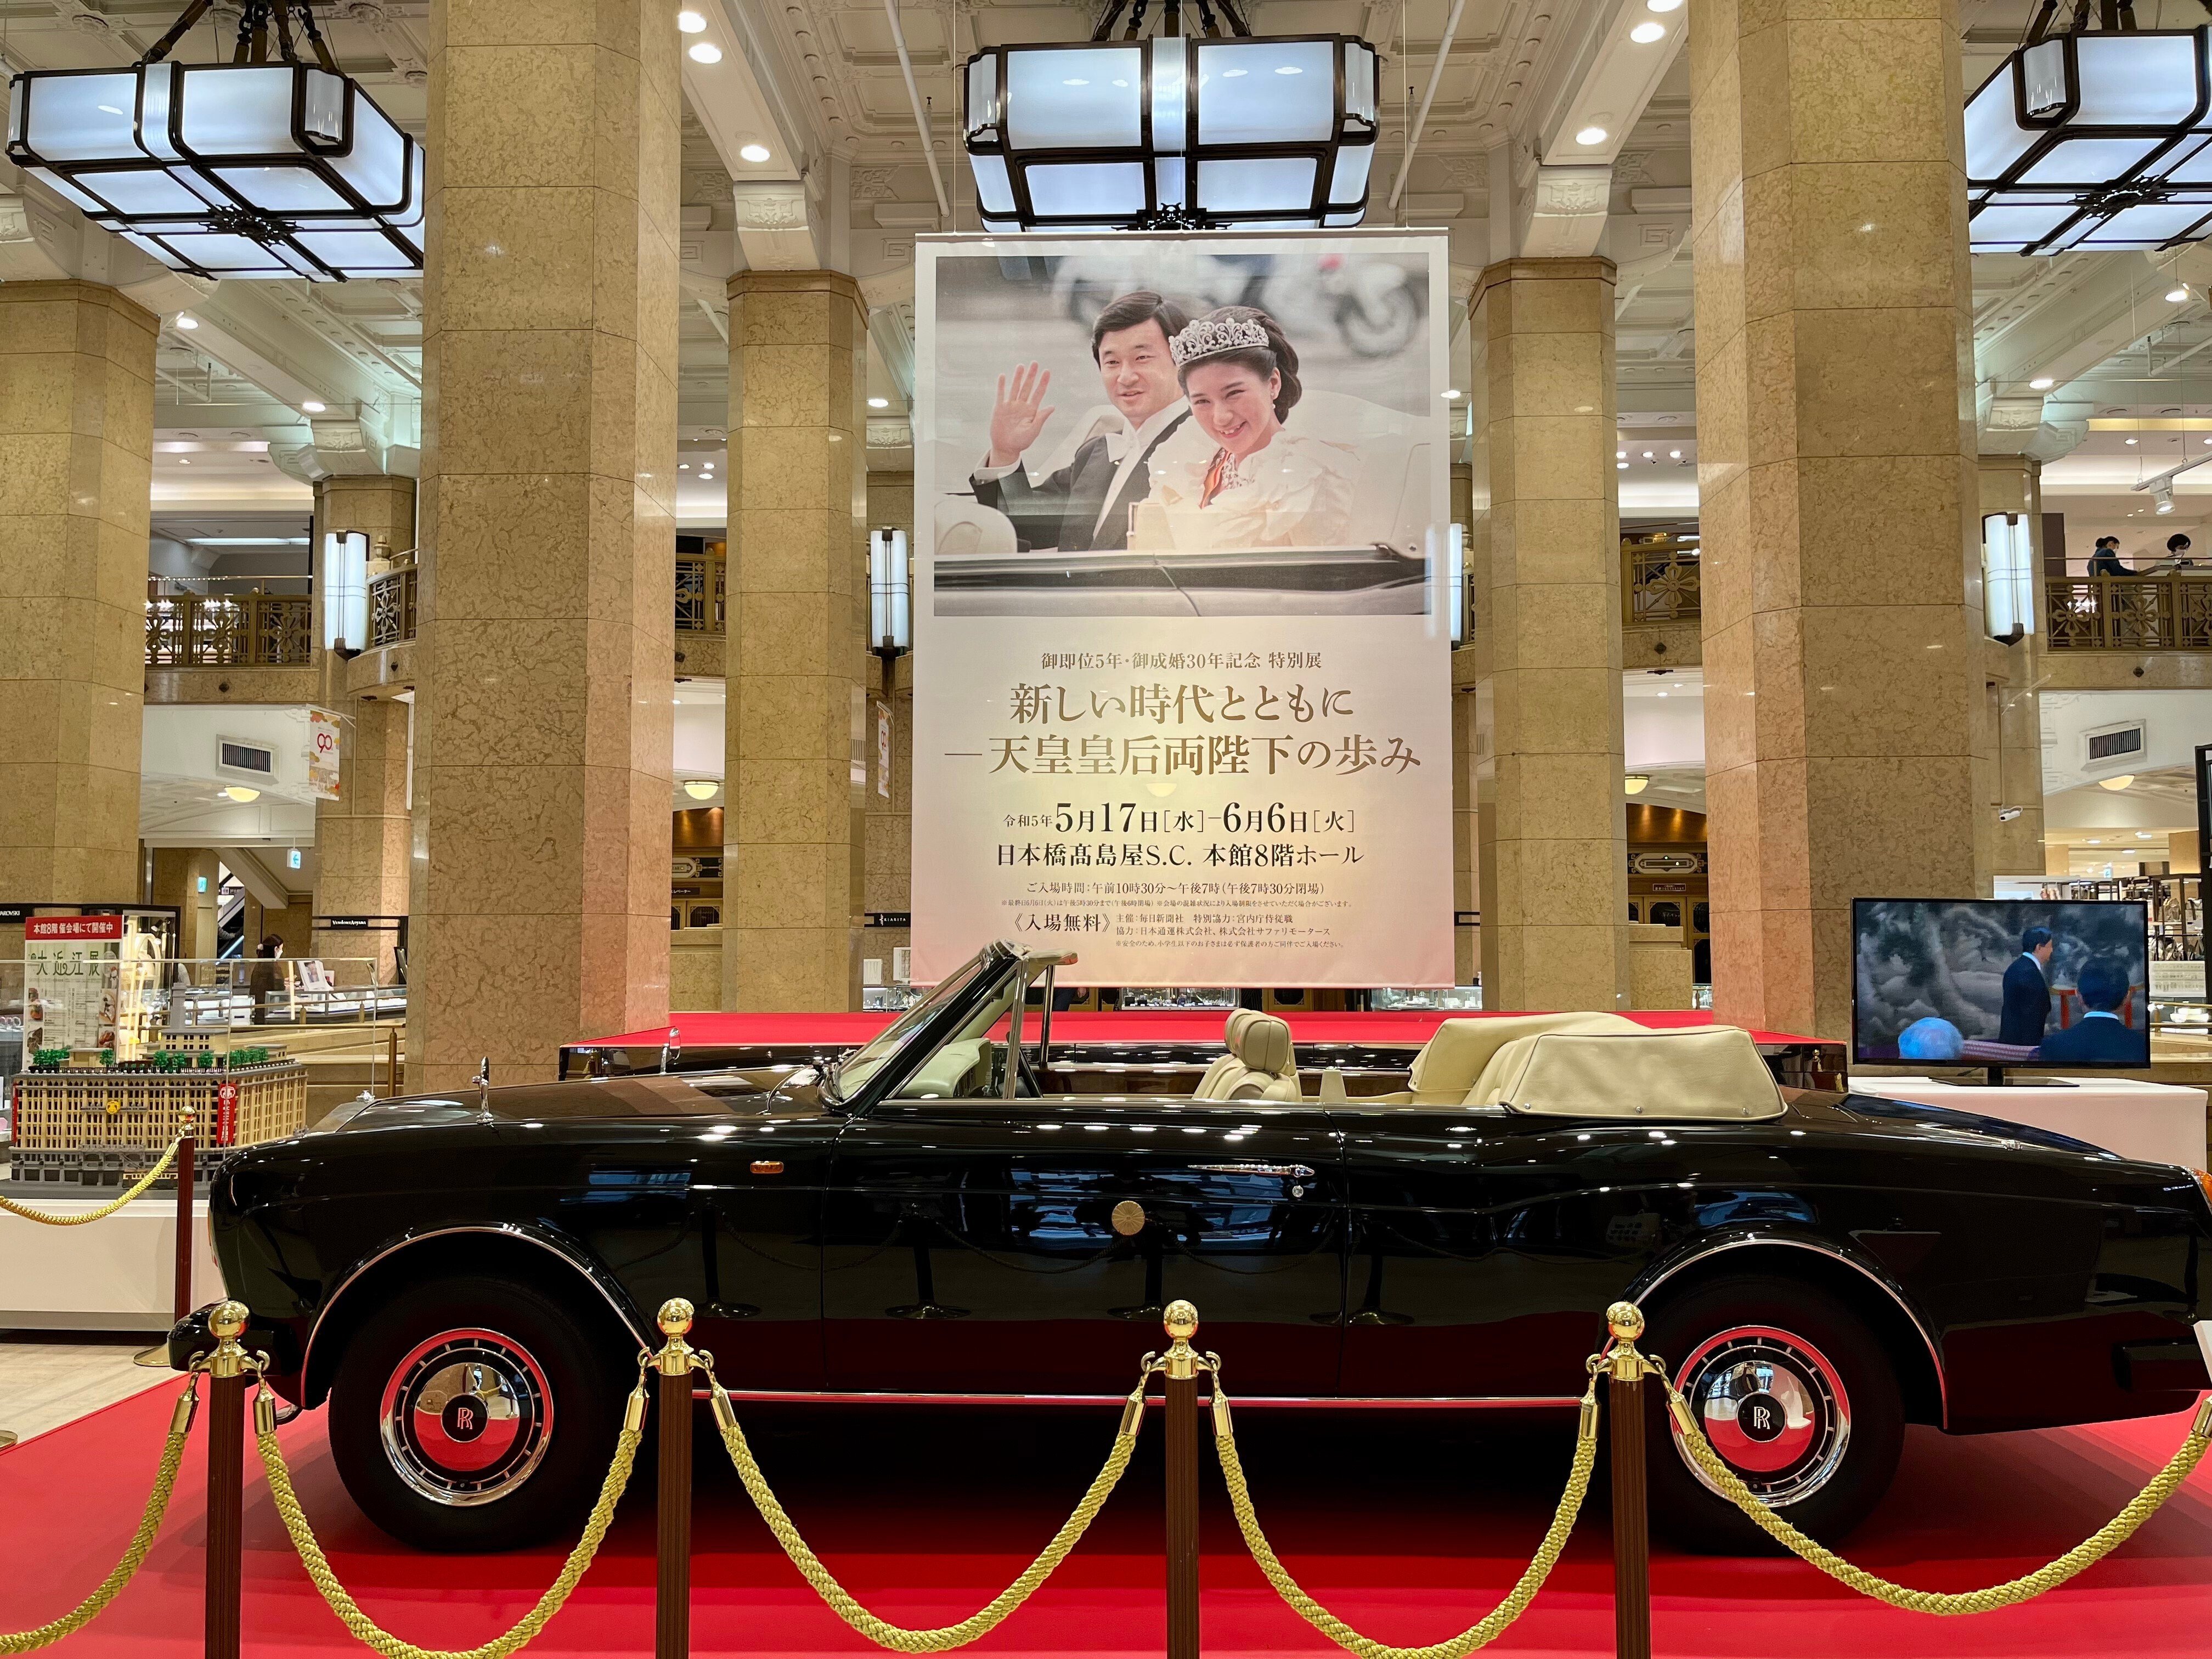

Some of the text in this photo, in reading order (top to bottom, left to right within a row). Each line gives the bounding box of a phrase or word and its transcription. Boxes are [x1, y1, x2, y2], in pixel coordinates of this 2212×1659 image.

[1041, 652, 1322, 670] 御即位5年・御成婚30年記念 特別展
[1010, 682, 1353, 724] 新しい時代とともに
[1203, 843, 1364, 867] 本館8階ホール
